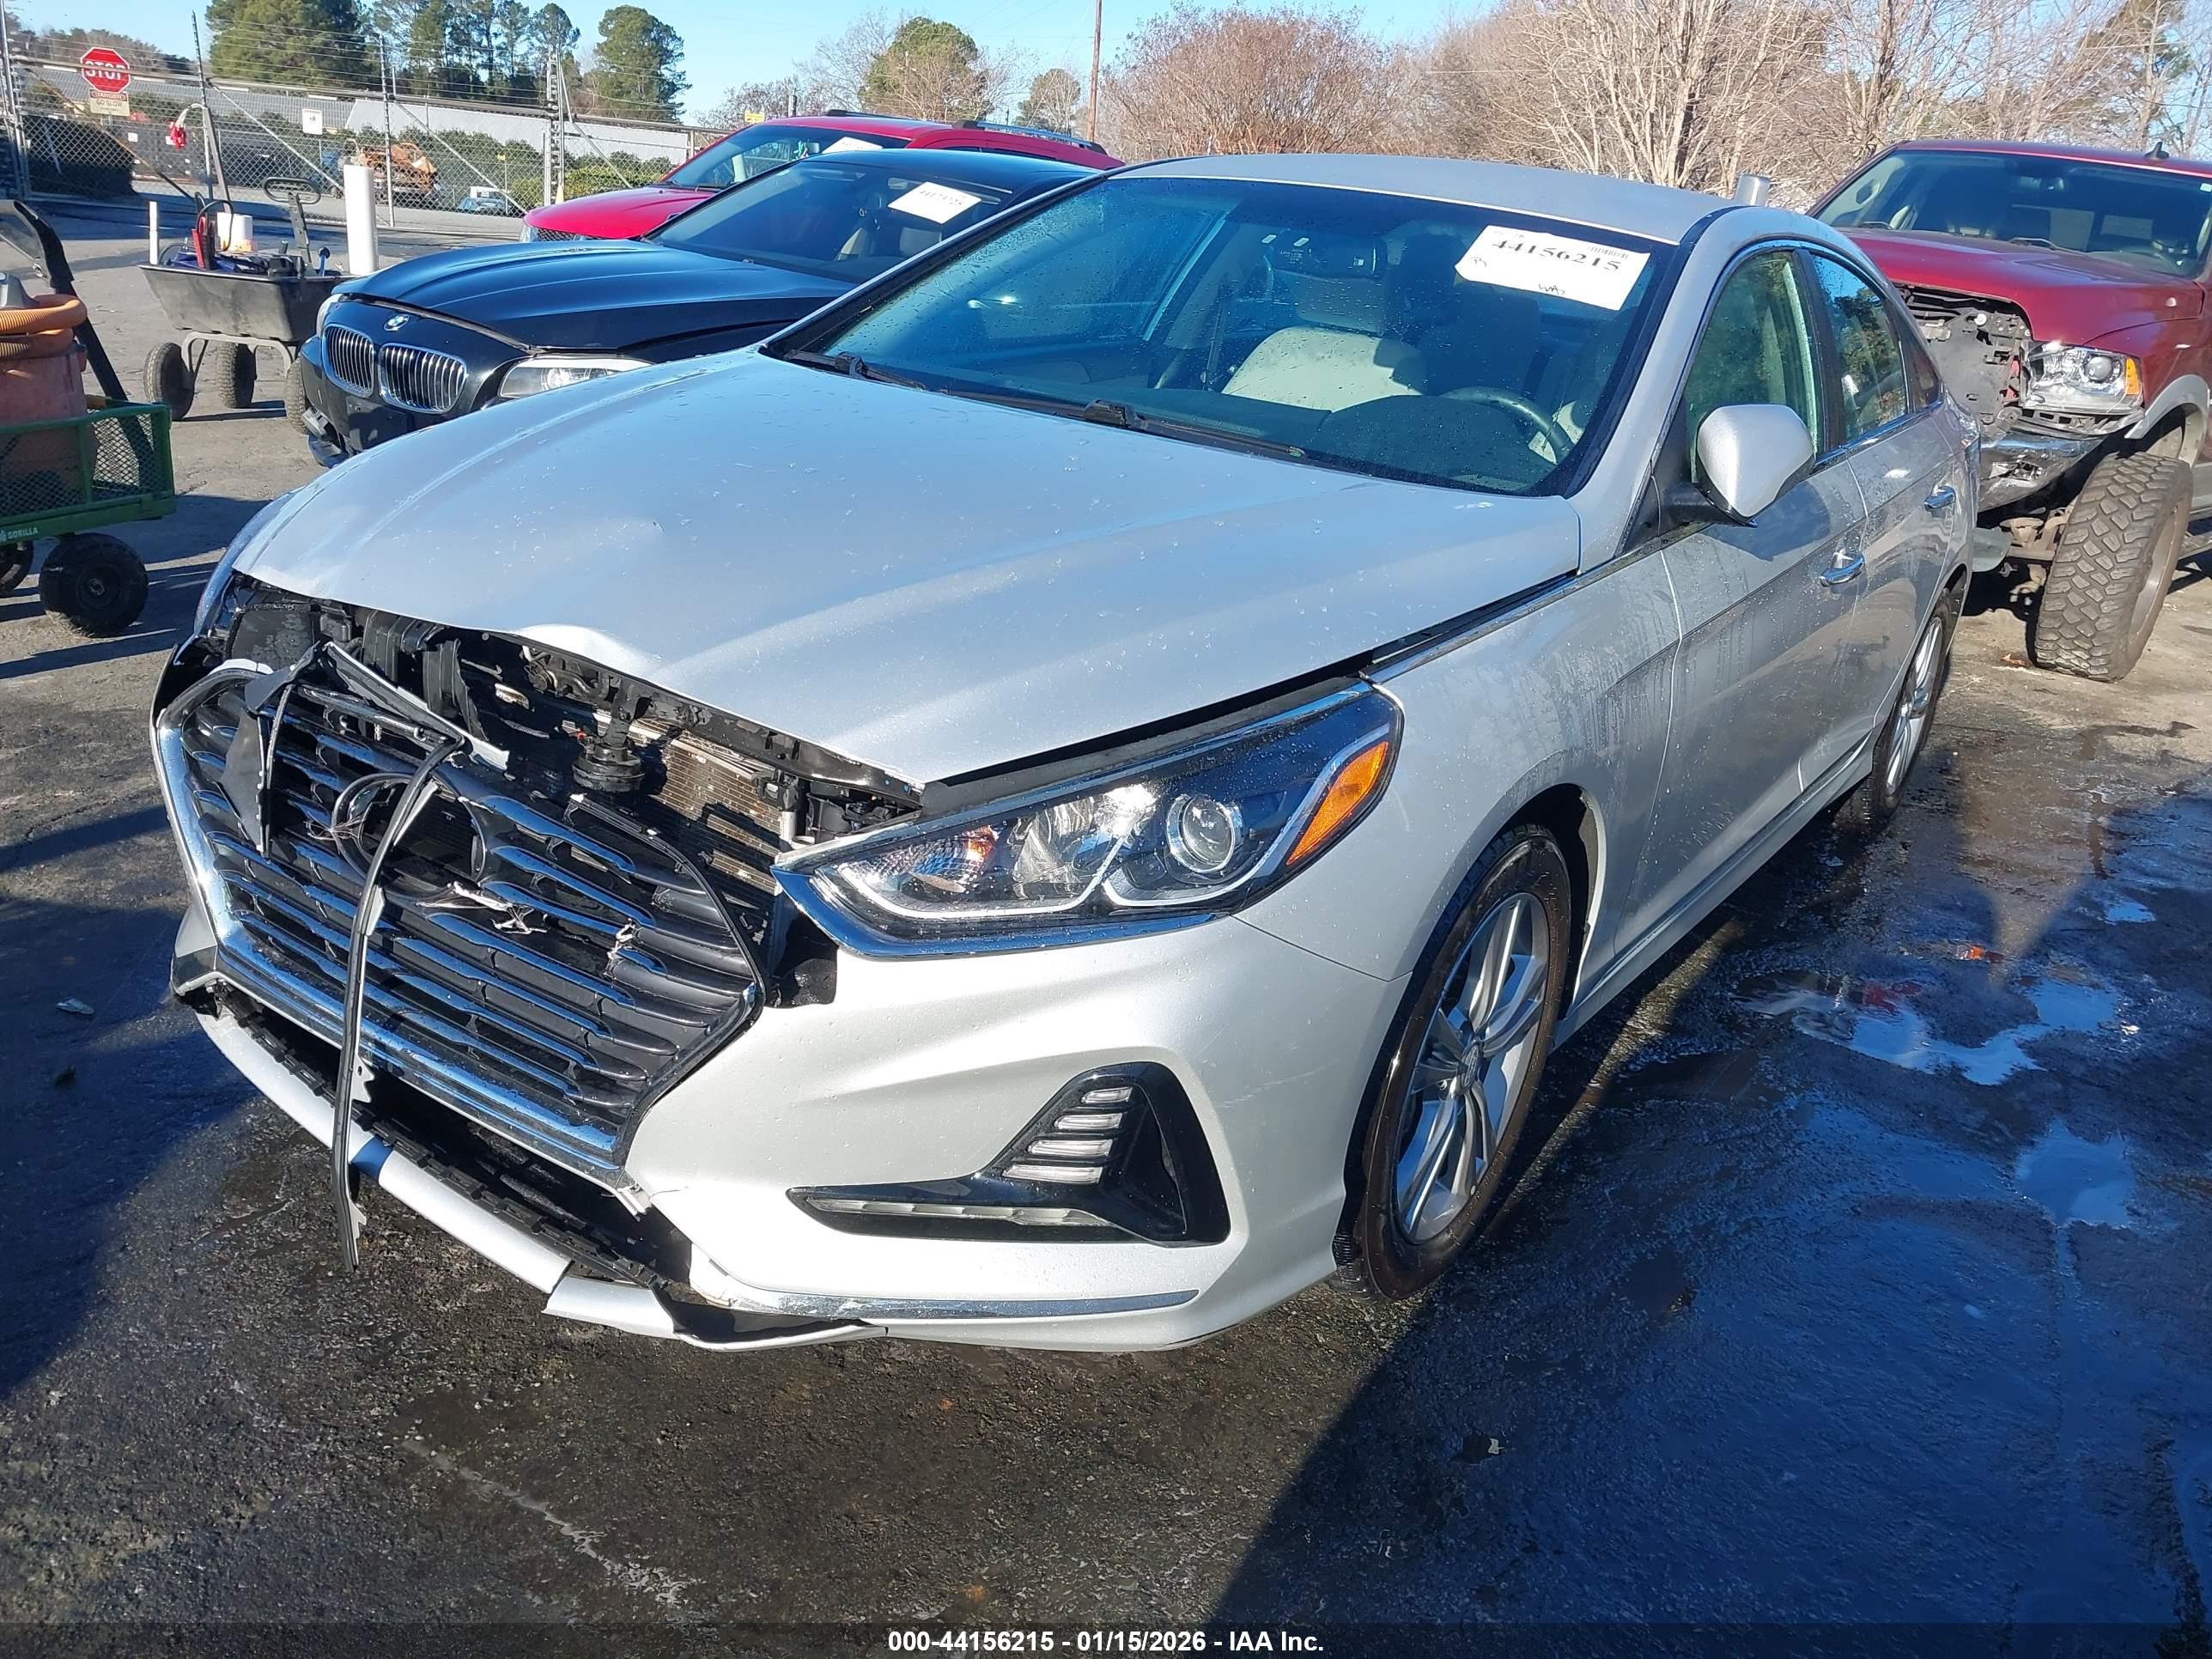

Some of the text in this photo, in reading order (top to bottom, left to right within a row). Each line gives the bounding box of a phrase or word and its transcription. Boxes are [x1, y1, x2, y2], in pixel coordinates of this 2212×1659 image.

[85, 60, 126, 80] STOP
[1492, 240, 1622, 271] 44156215
[8, 527, 39, 539] GORILLA
